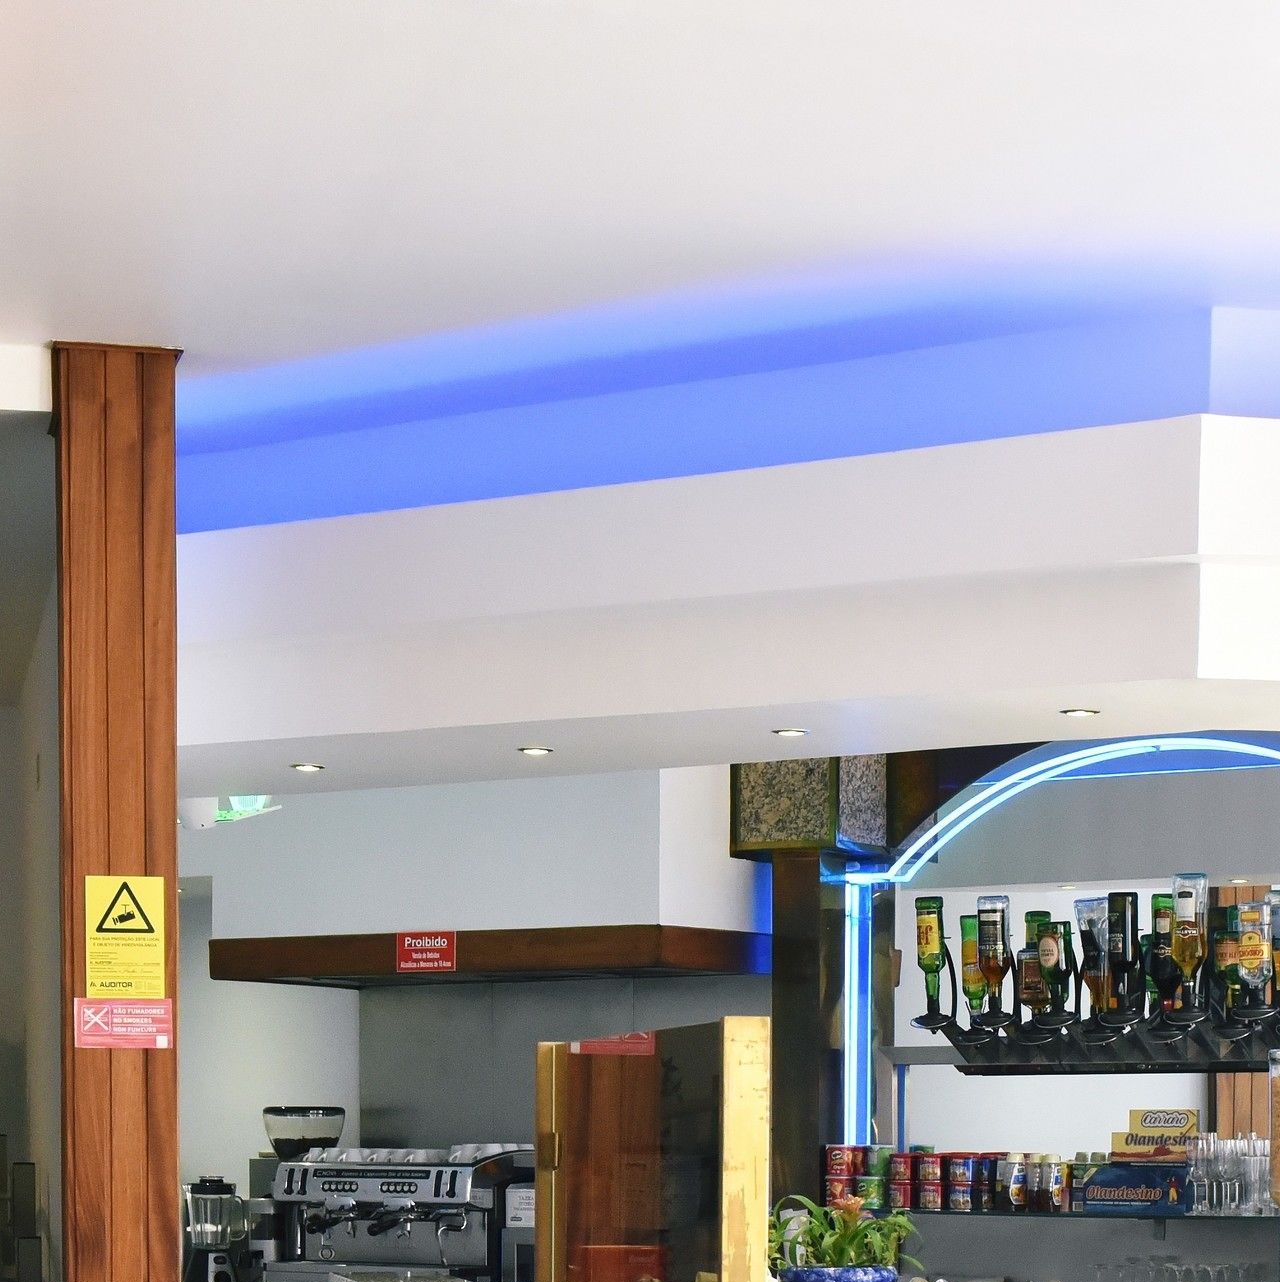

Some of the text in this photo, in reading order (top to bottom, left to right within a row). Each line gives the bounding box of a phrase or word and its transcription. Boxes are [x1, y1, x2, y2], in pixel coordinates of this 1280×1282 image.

[404, 936, 448, 947] Proibido
[112, 1007, 165, 1015] NÃO FUMADORES
[1143, 1112, 1186, 1125] Carraro
[1086, 1185, 1162, 1200] Olandesino
